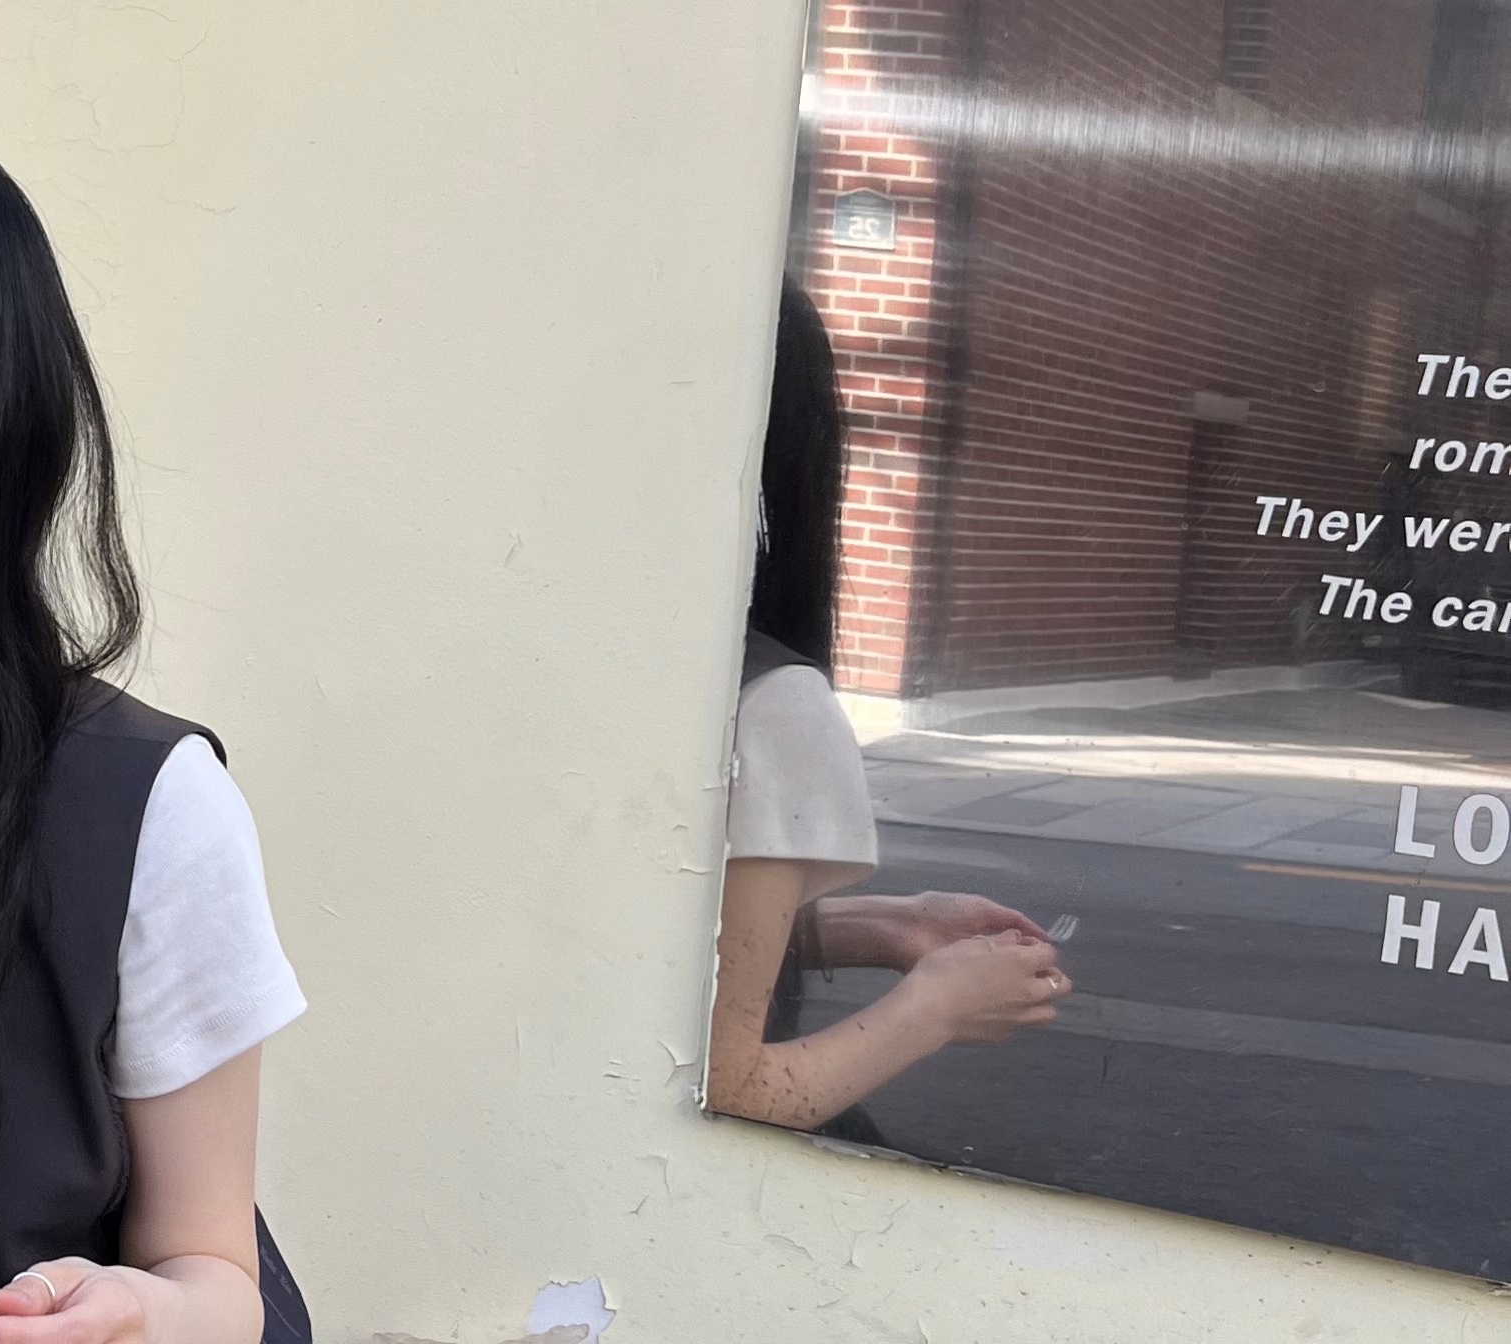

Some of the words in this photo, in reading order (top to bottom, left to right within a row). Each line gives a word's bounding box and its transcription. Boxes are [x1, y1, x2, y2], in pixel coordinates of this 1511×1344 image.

[1255, 495, 1384, 552] They
[1404, 516, 1511, 554] wer
[1318, 573, 1412, 623] The
[1394, 784, 1510, 866] LO
[1381, 894, 1510, 983] HA
